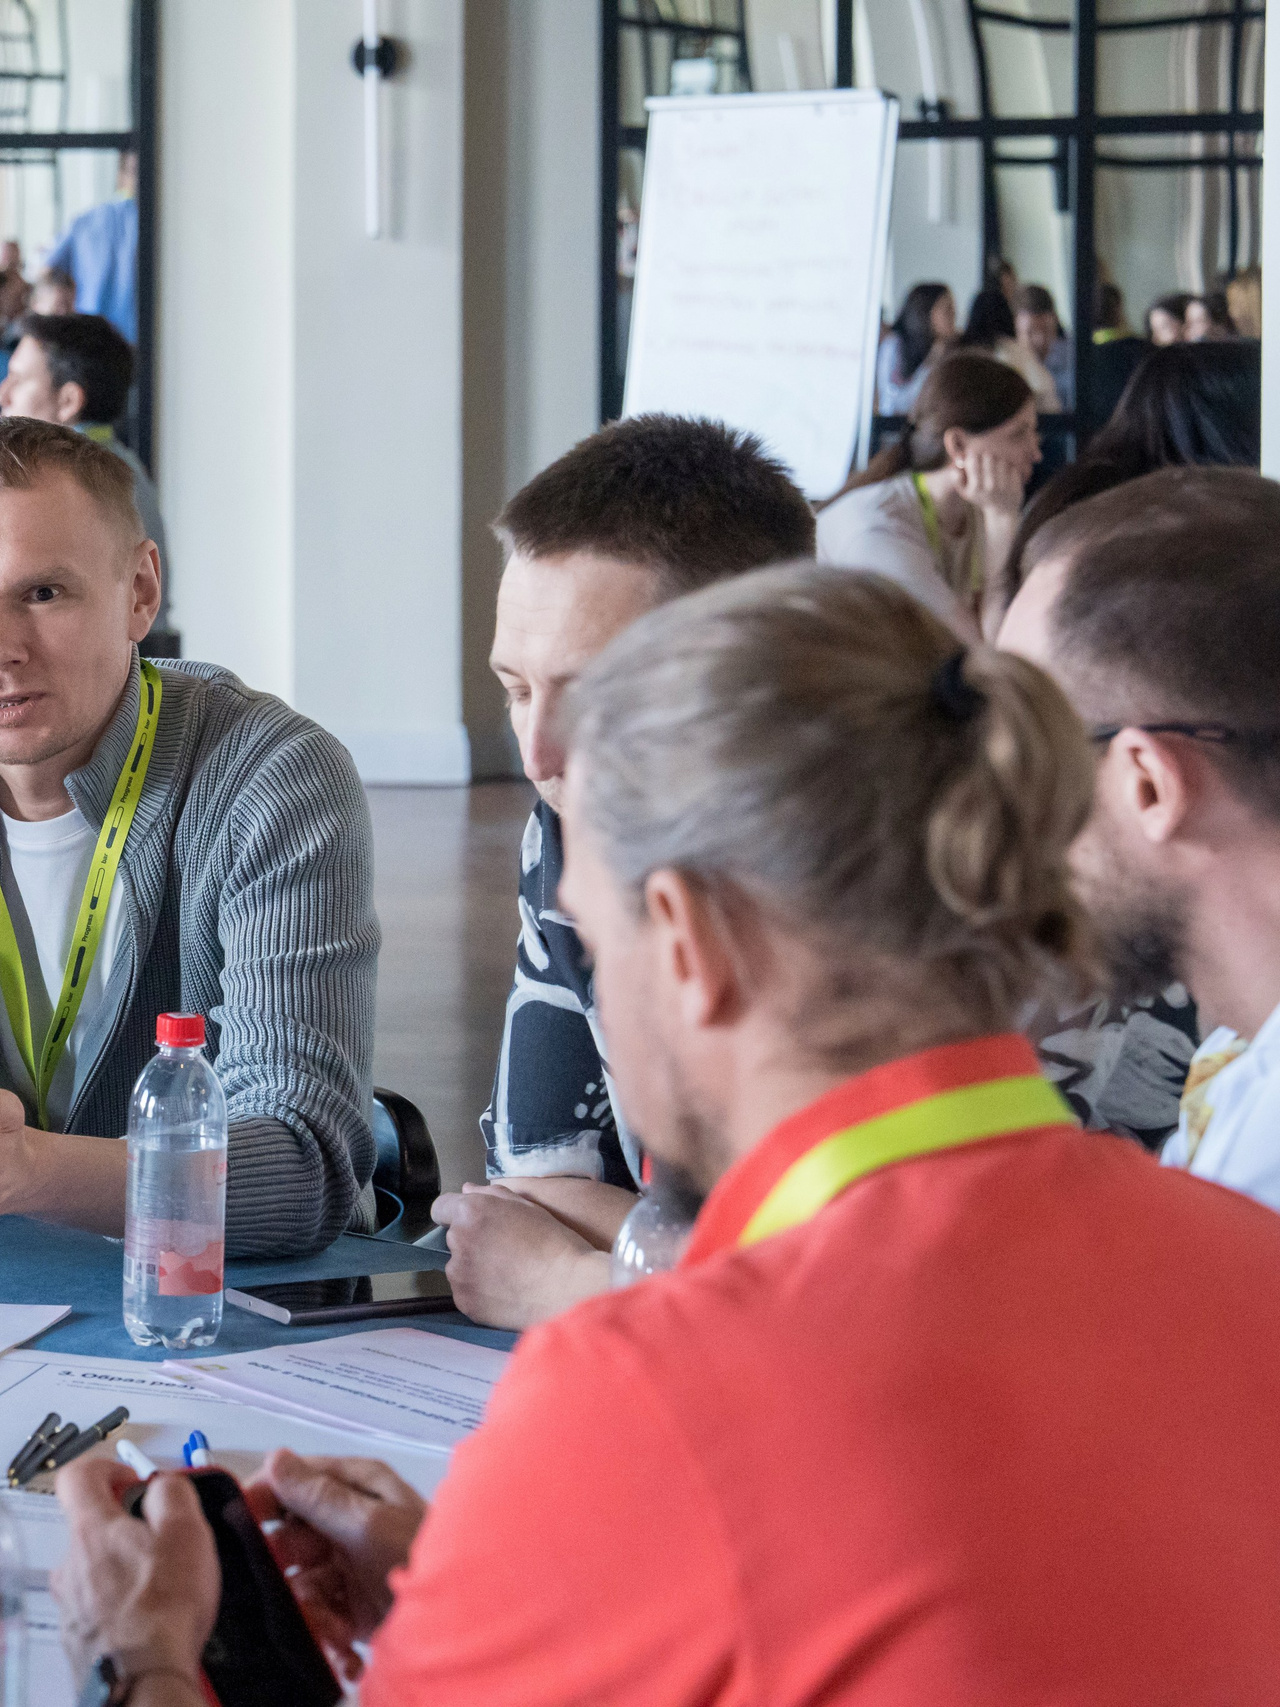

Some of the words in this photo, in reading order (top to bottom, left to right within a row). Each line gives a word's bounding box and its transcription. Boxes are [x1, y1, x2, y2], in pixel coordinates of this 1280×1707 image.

[81, 914, 93, 942] Progress
[120, 776, 134, 803] Progress
[81, 1372, 146, 1384] Образ
